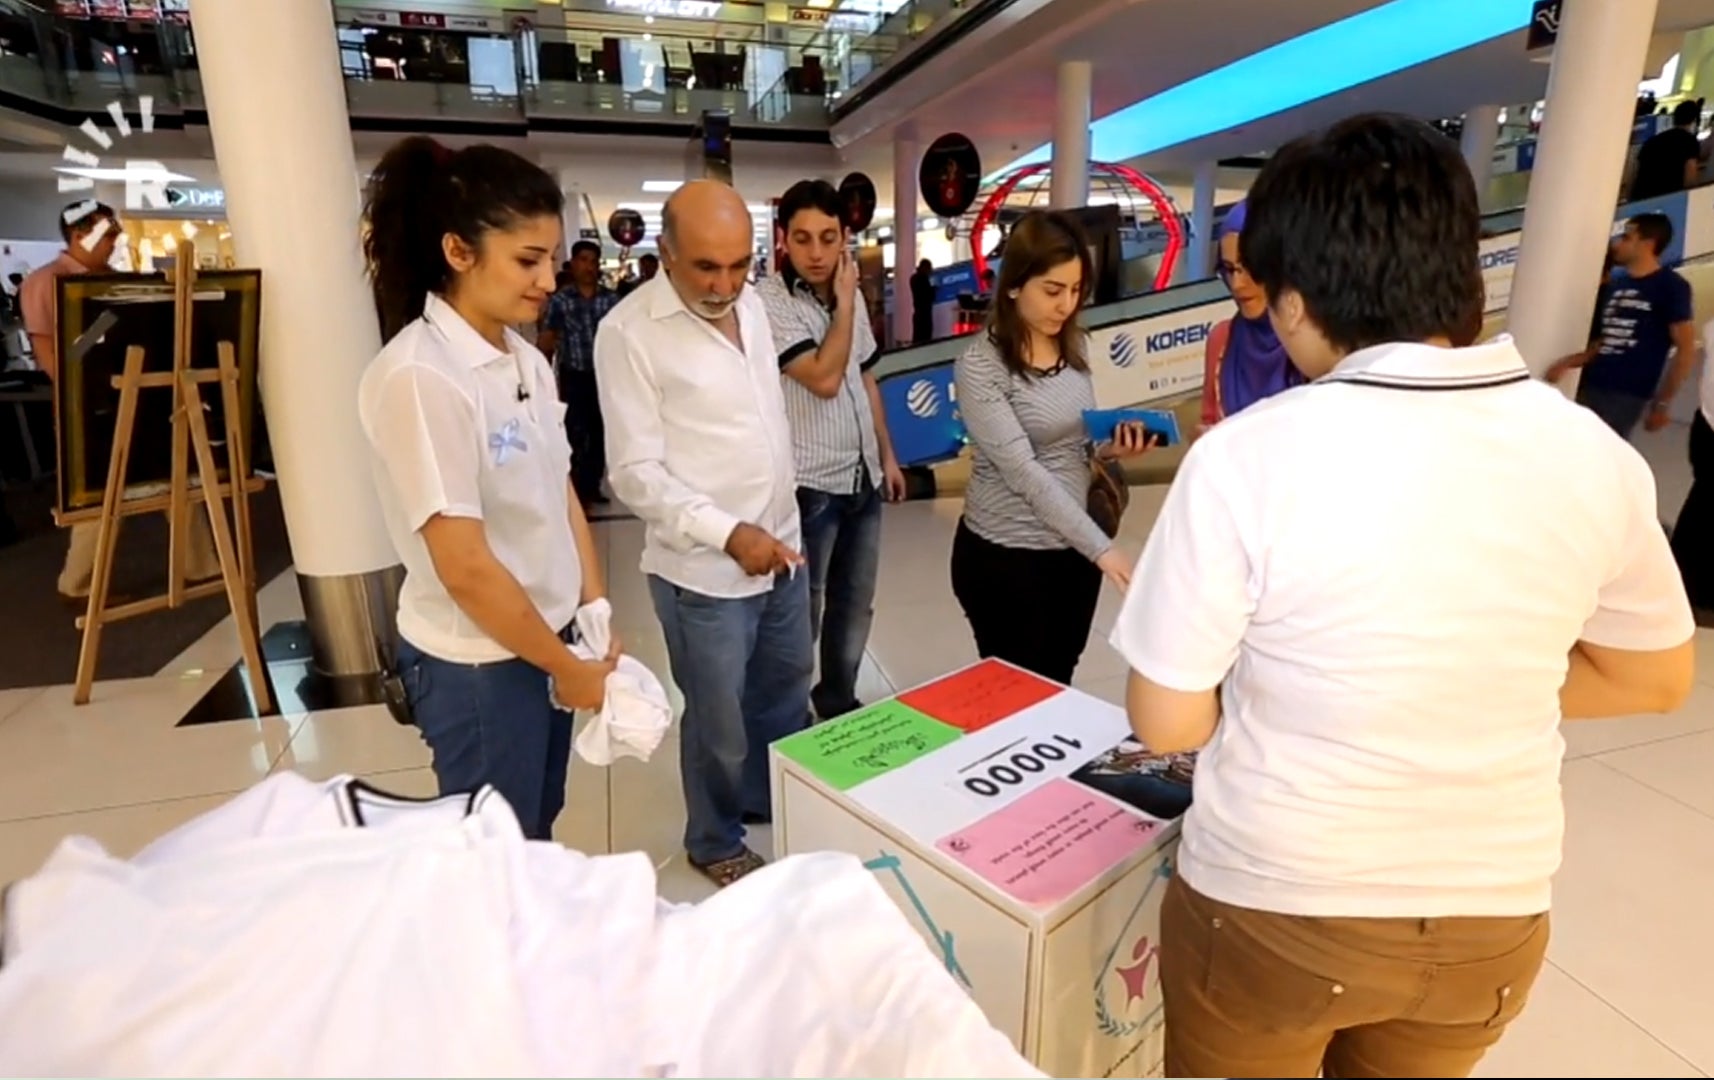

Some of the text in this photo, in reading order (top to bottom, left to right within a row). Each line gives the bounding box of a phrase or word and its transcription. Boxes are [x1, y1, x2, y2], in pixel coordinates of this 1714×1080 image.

[422, 16, 438, 25] LG
[1146, 321, 1212, 353] KOREK
[964, 735, 1082, 798] 10000
